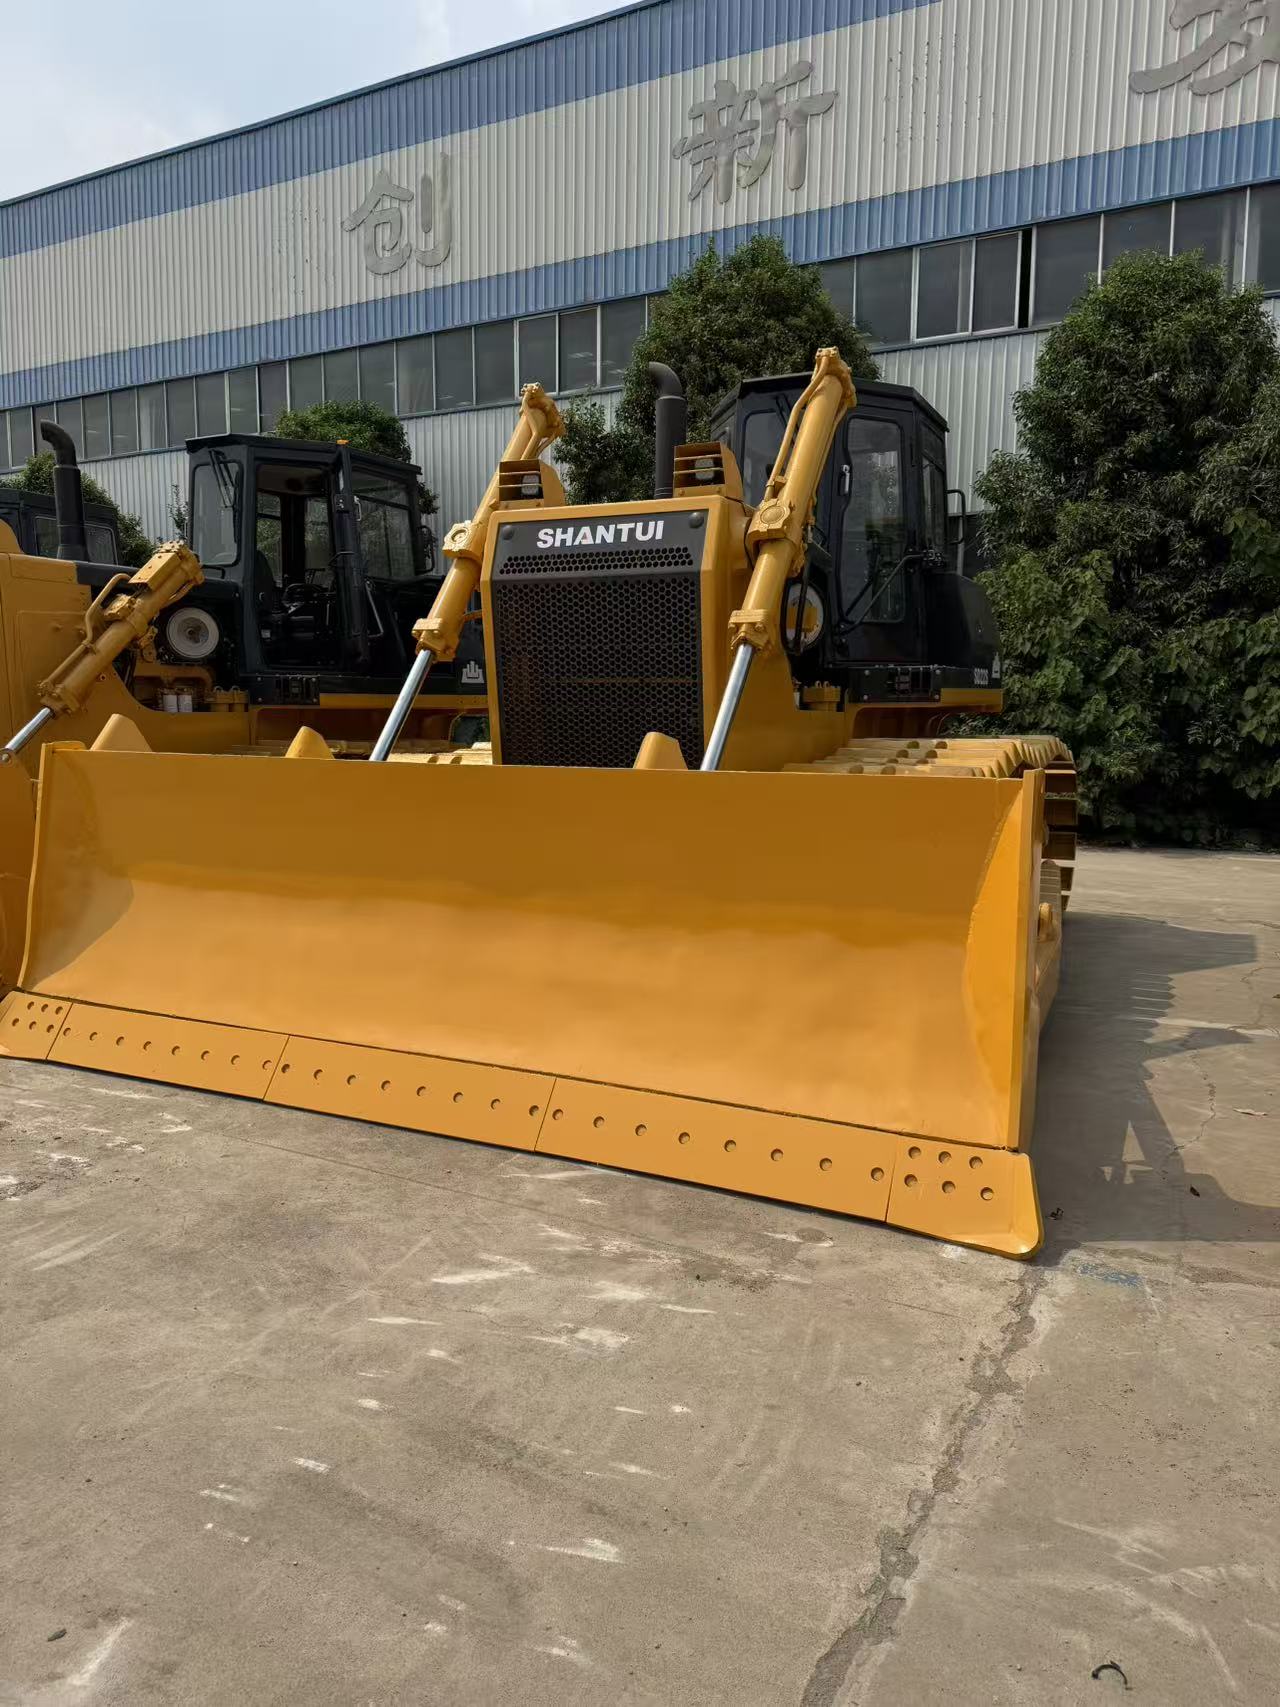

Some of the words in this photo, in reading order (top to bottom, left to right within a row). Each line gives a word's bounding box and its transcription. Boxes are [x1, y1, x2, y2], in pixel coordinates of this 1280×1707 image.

[340, 151, 452, 276] 创
[672, 60, 839, 205] 新
[537, 520, 665, 549] SHANTUI
